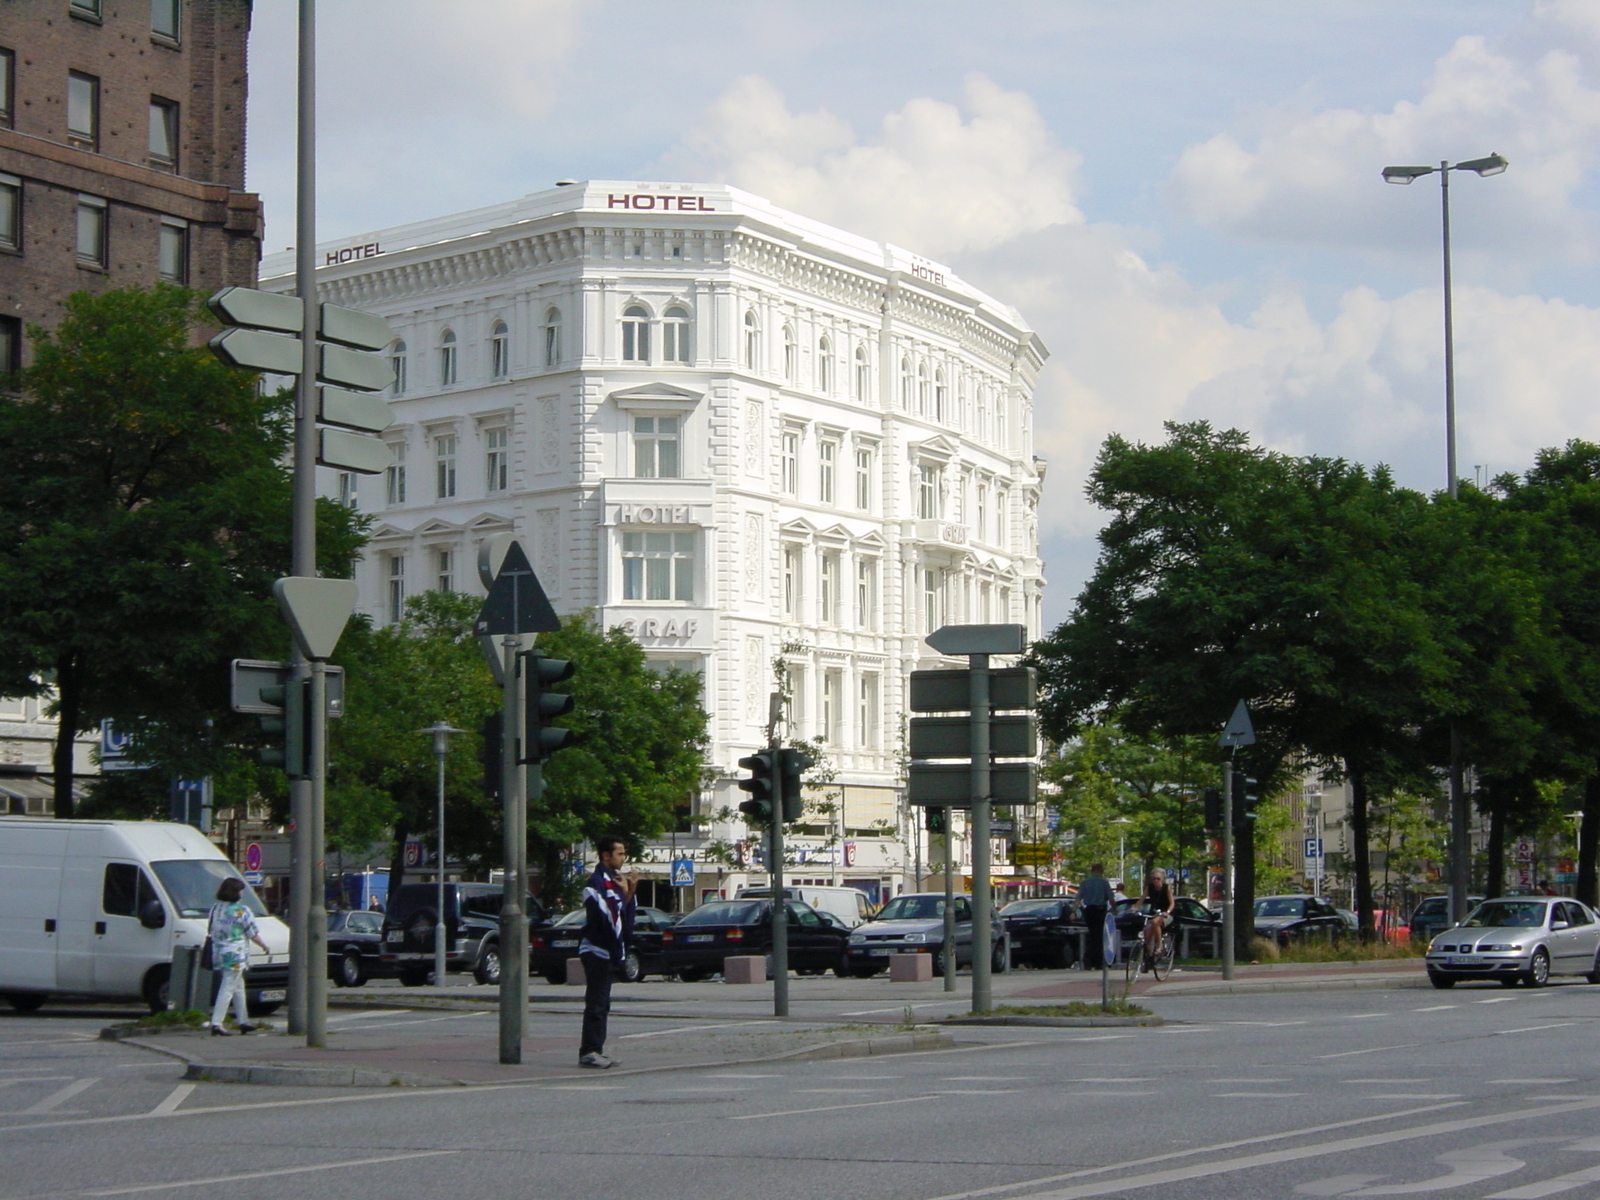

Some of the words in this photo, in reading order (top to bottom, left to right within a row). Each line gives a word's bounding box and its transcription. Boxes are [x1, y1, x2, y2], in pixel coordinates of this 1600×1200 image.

[608, 194, 715, 211] HOTEL
[326, 242, 385, 265] HOTEL
[911, 263, 947, 287] HOTEL
[621, 504, 699, 524] HOTEL
[622, 617, 698, 637] GRAF
